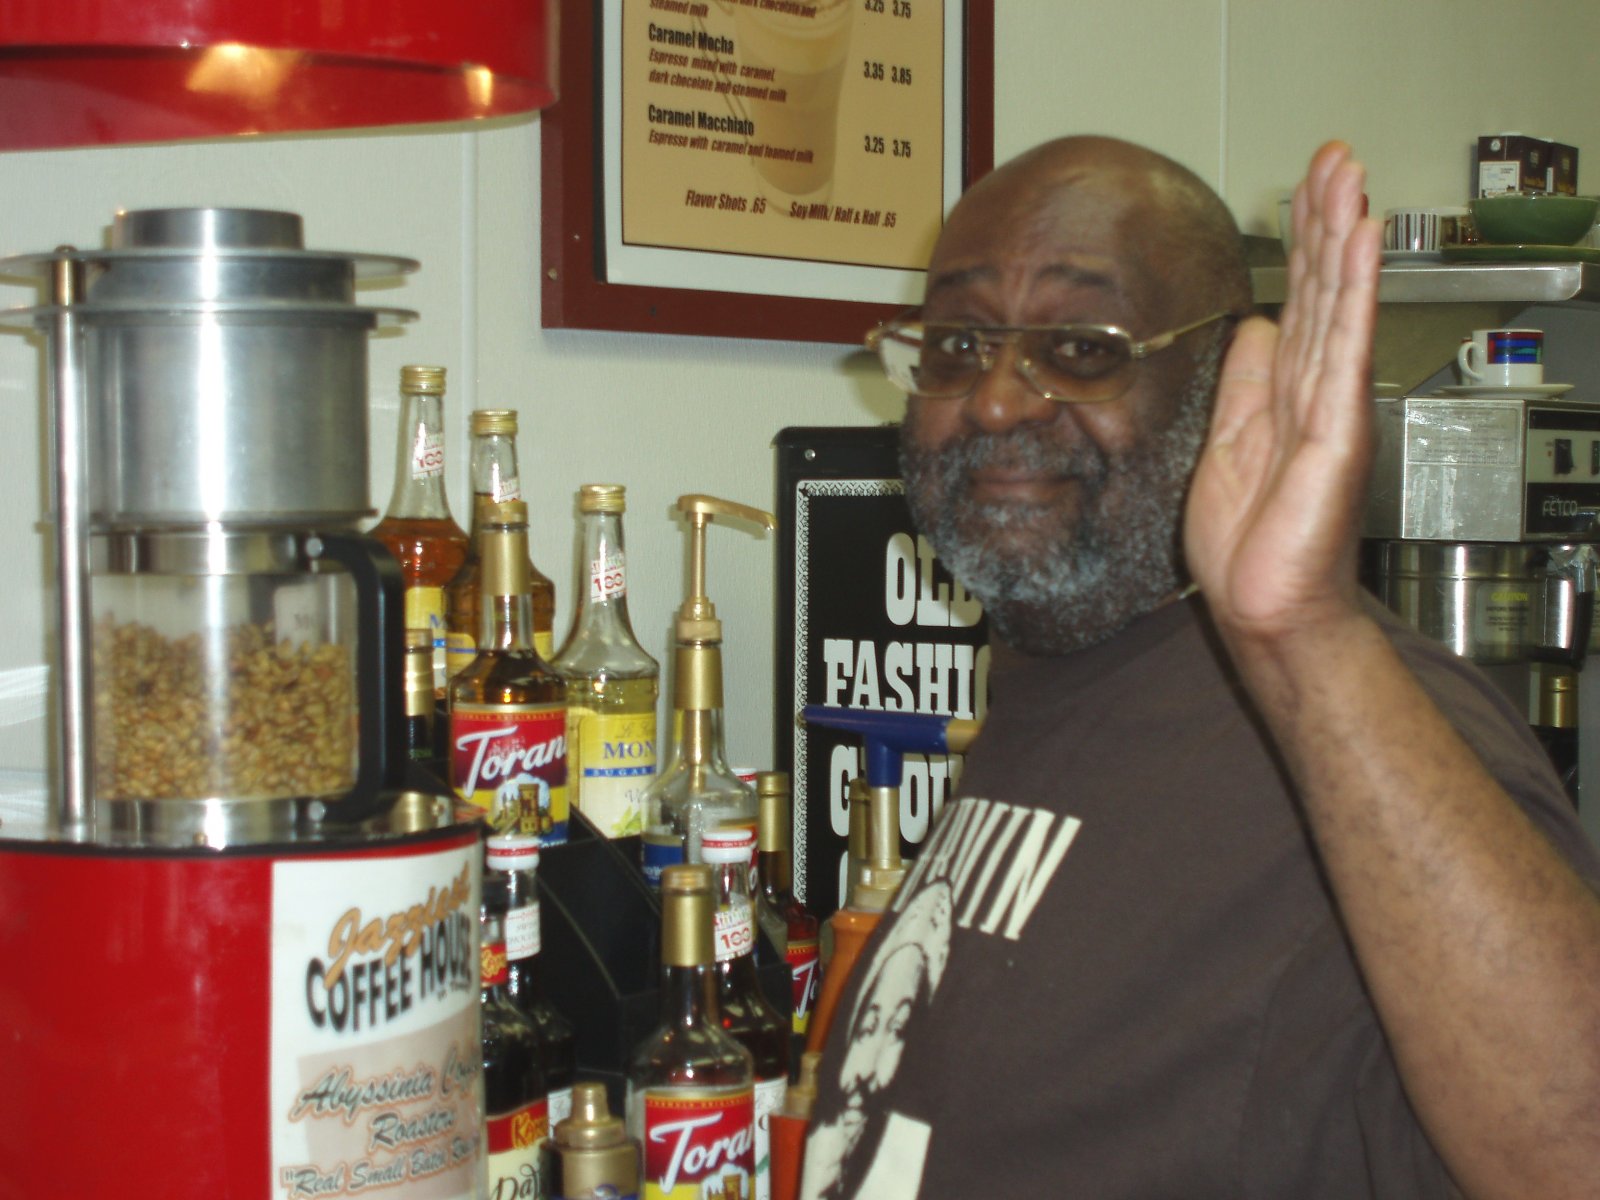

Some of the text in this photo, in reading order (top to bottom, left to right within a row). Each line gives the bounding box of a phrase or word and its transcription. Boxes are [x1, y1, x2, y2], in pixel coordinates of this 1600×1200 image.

[649, 23, 734, 54] Caramel Mocha
[649, 48, 689, 67] Espresso
[691, 57, 718, 73] mixed
[718, 60, 737, 75] with
[864, 61, 911, 85] 3.35 3.85
[649, 70, 787, 103] dark chocolate and steamed milk
[648, 104, 754, 136] Caramel Macchiato
[649, 129, 689, 147] Espresso
[690, 135, 708, 150] with
[711, 138, 748, 154] caramel
[748, 145, 764, 157] and
[796, 151, 814, 164] milk
[865, 135, 911, 158] 3.25 3.75
[685, 189, 717, 209] Flavor
[718, 193, 747, 212] Shots
[790, 201, 808, 220] Soy
[834, 206, 854, 224] Half
[854, 210, 861, 224] &
[862, 210, 881, 226] Half
[350, 1156, 405, 1188] Small
